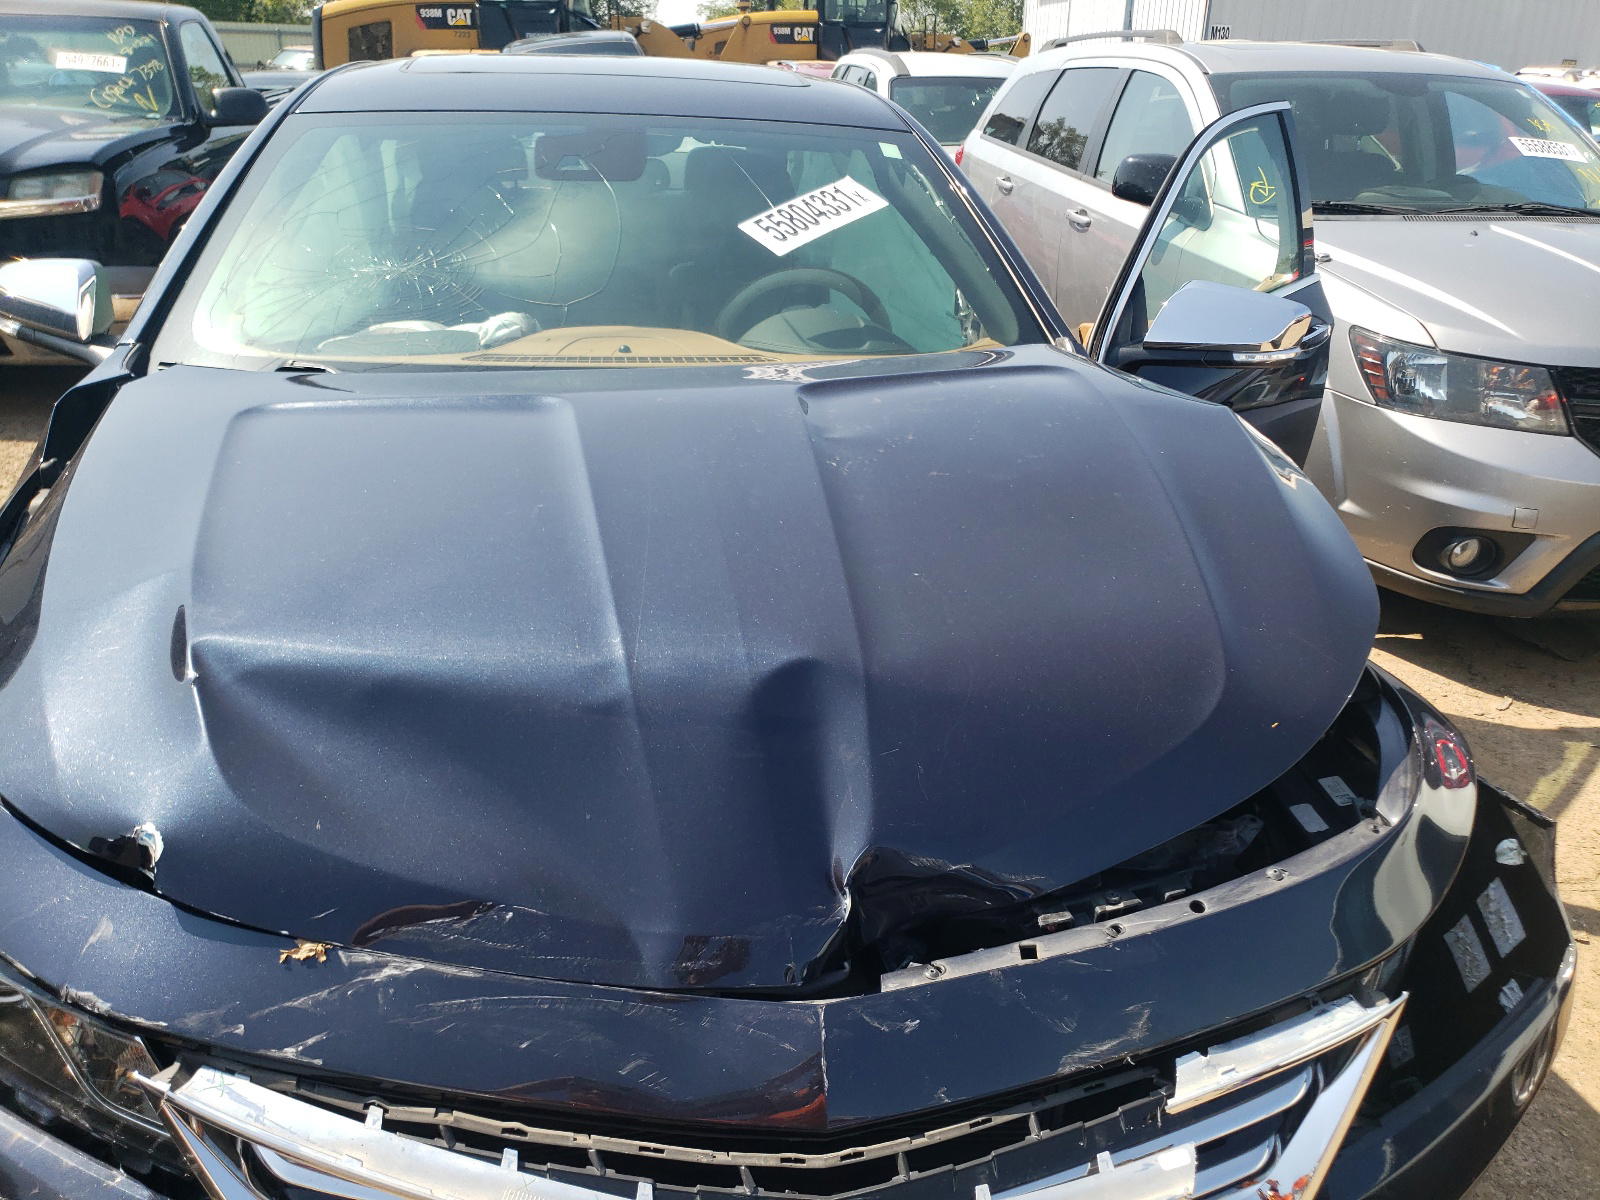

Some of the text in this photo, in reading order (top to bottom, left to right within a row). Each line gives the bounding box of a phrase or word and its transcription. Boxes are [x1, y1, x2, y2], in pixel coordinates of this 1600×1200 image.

[420, 8, 472, 26] 938M CAT
[793, 27, 815, 42] CAT
[1210, 26, 1230, 40] M130
[753, 186, 862, 242] 55804331
